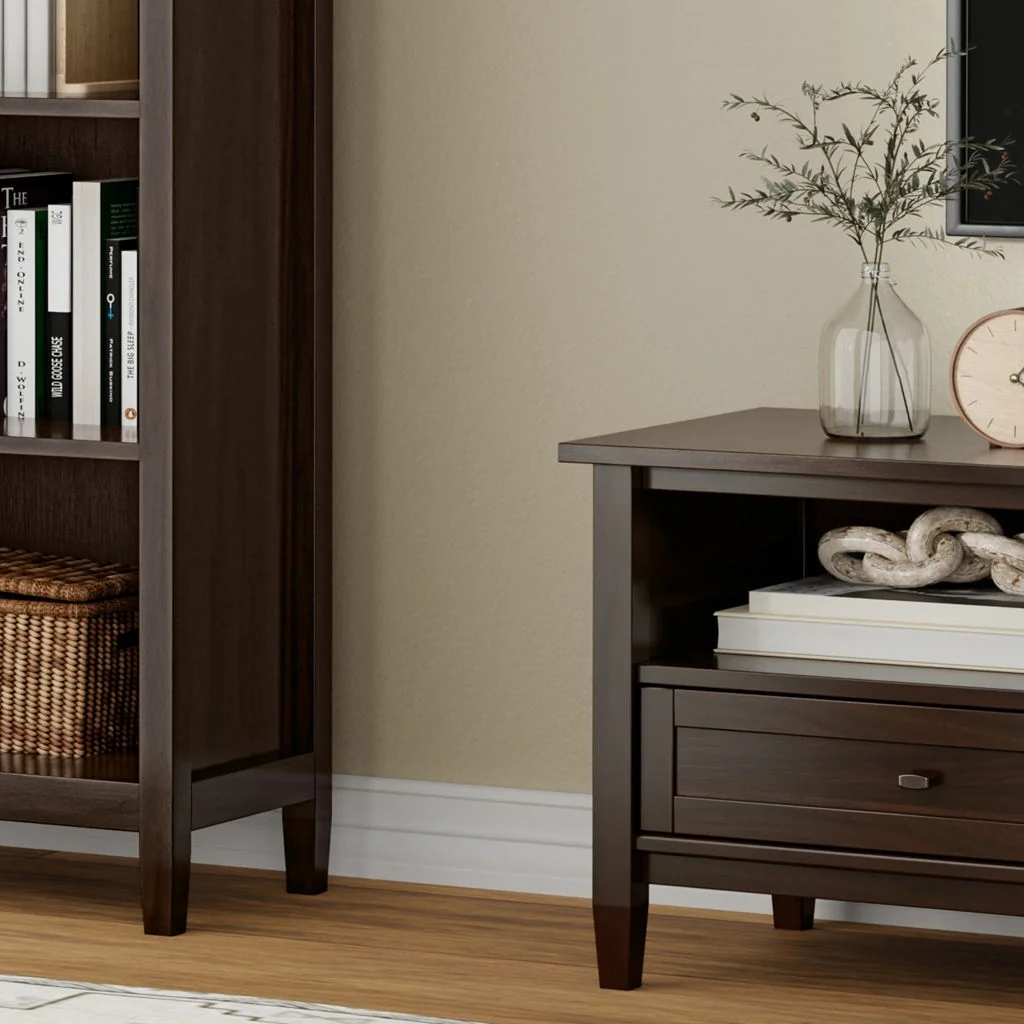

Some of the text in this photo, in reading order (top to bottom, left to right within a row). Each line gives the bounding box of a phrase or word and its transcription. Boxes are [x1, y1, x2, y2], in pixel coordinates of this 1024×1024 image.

[1, 186, 28, 210] THE
[126, 331, 135, 352] SLEEP
[50, 336, 63, 398] WILD GOOSE CHASE
[126, 353, 135, 365] BIG
[126, 367, 135, 379] THE
